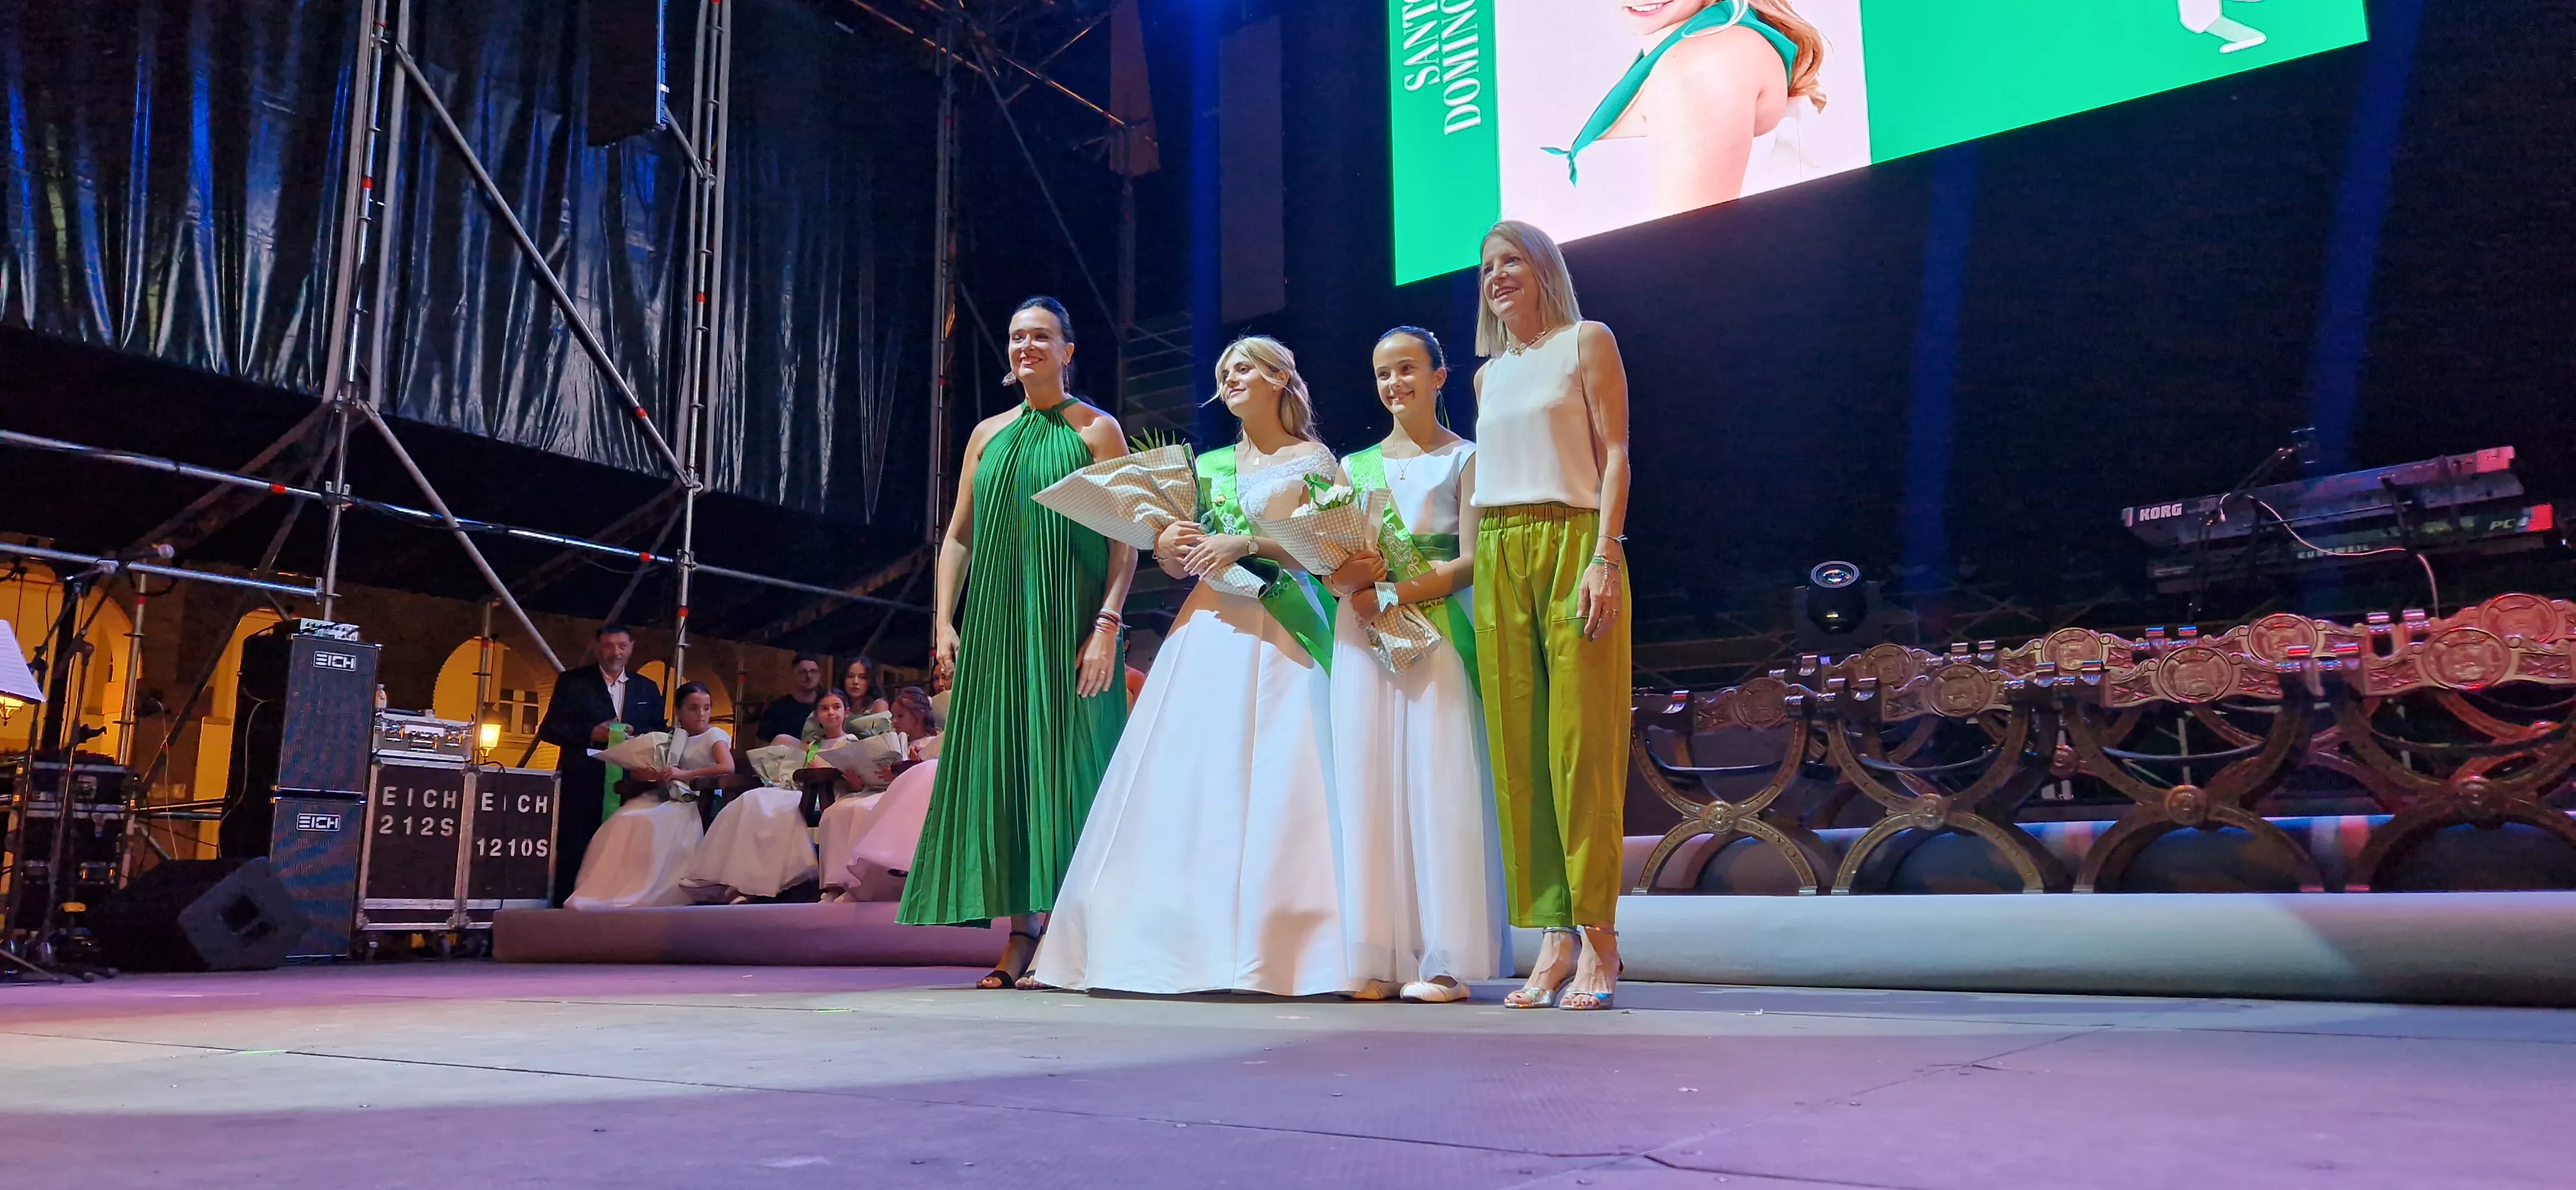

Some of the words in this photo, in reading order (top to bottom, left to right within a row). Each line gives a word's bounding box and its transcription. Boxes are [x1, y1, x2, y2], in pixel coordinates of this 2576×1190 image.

[1402, 0, 1440, 91] SANT
[2139, 503, 2183, 522] KORG
[316, 654, 355, 669] EICH
[383, 786, 457, 809] EICH
[481, 792, 548, 813] EICH
[299, 816, 339, 829] EICH
[379, 815, 454, 836] 212S
[477, 838, 548, 857] 1210S
